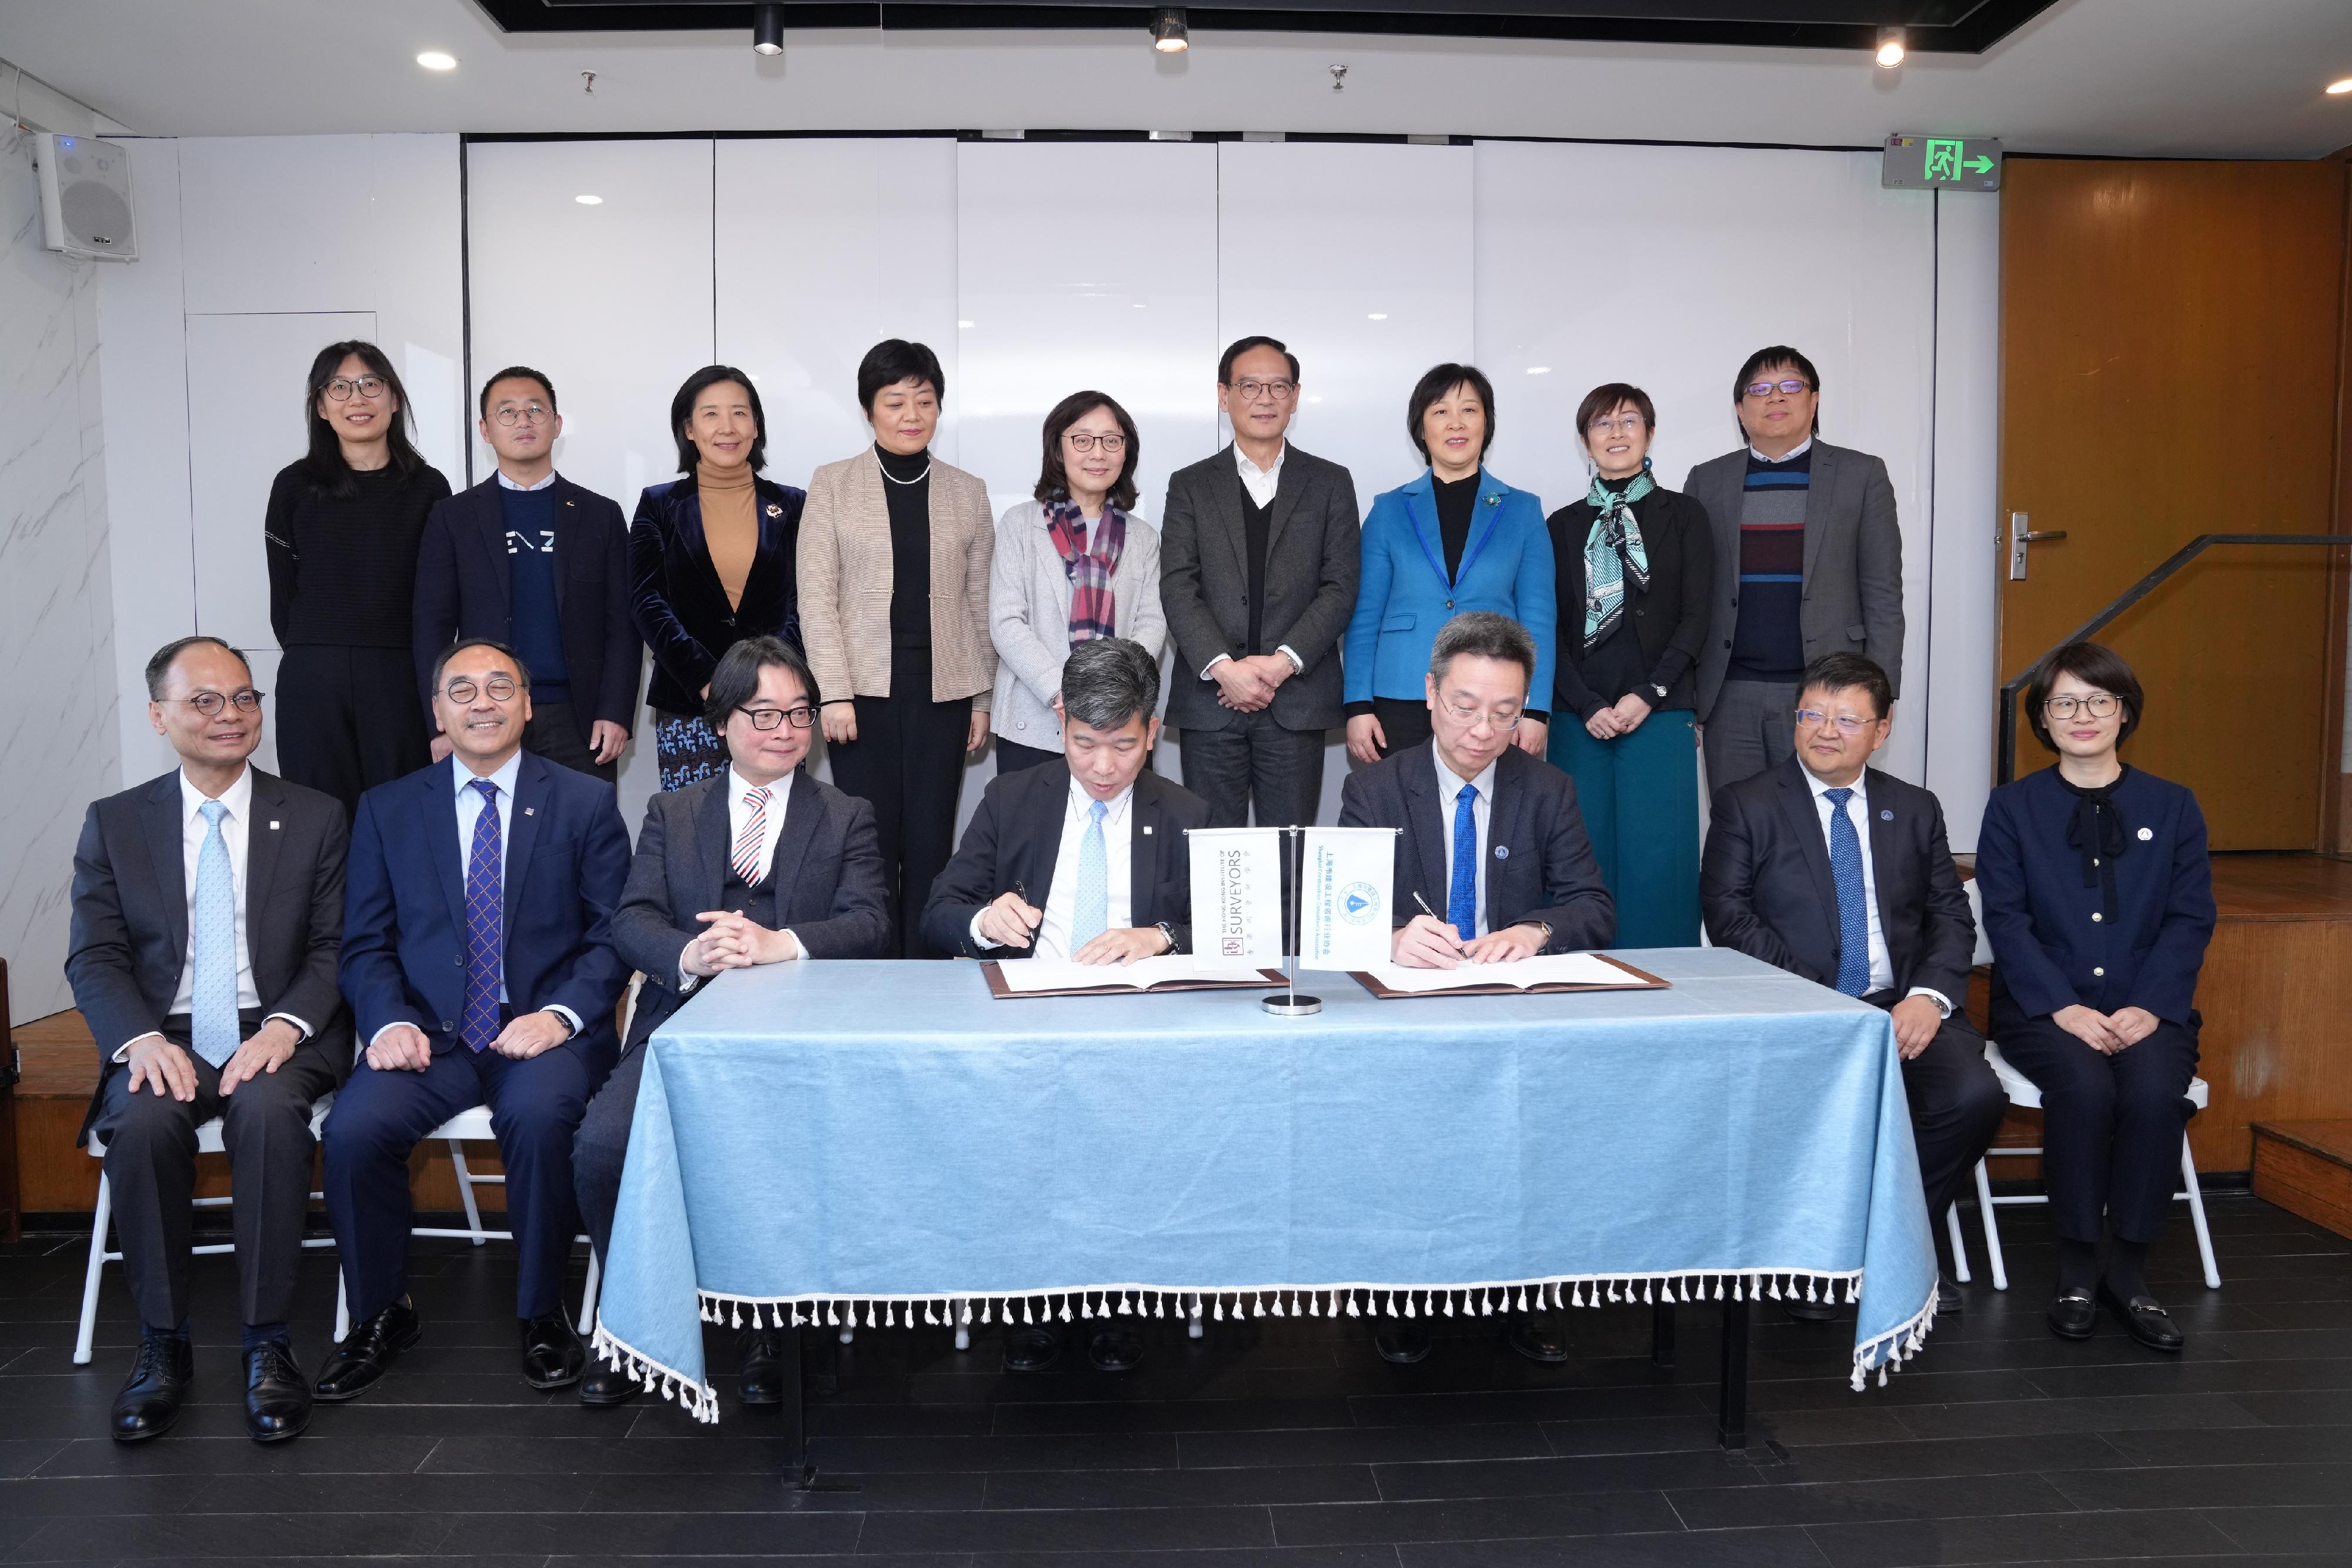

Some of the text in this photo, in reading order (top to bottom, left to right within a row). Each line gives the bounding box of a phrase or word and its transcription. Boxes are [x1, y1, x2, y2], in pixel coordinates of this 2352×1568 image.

[1228, 850, 1242, 934] SURVEYORS
[1322, 851, 1334, 956] 上海市建设工程咨询行业协会
